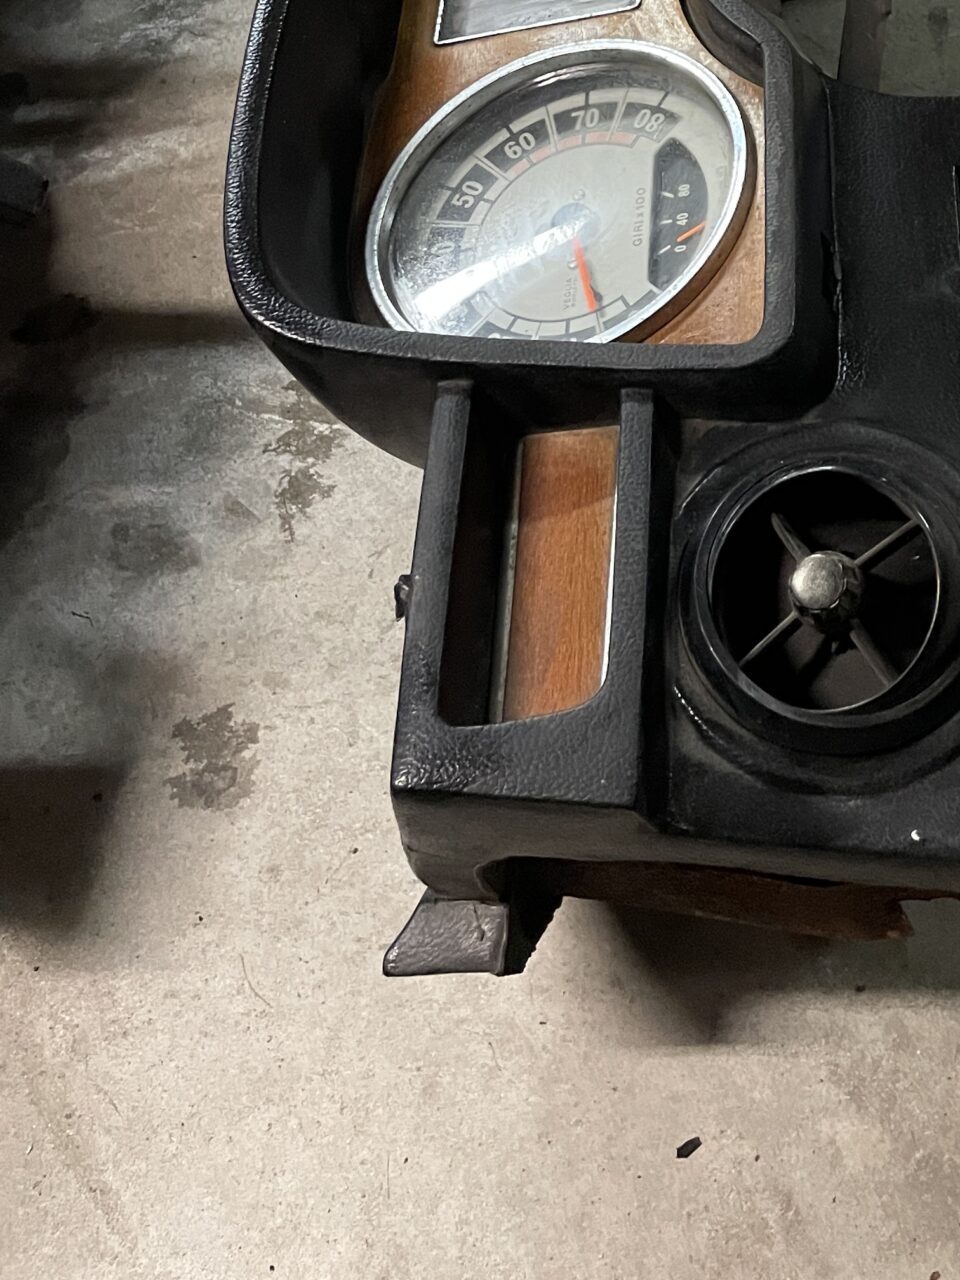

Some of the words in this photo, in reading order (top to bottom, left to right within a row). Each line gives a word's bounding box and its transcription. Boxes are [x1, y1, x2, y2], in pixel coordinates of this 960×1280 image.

[570, 108, 600, 131] 70
[633, 108, 665, 132] 80
[503, 131, 536, 160] 60
[451, 180, 484, 209] 50
[678, 183, 690, 198] 80
[676, 212, 689, 226] 40
[673, 244, 687, 253] 0
